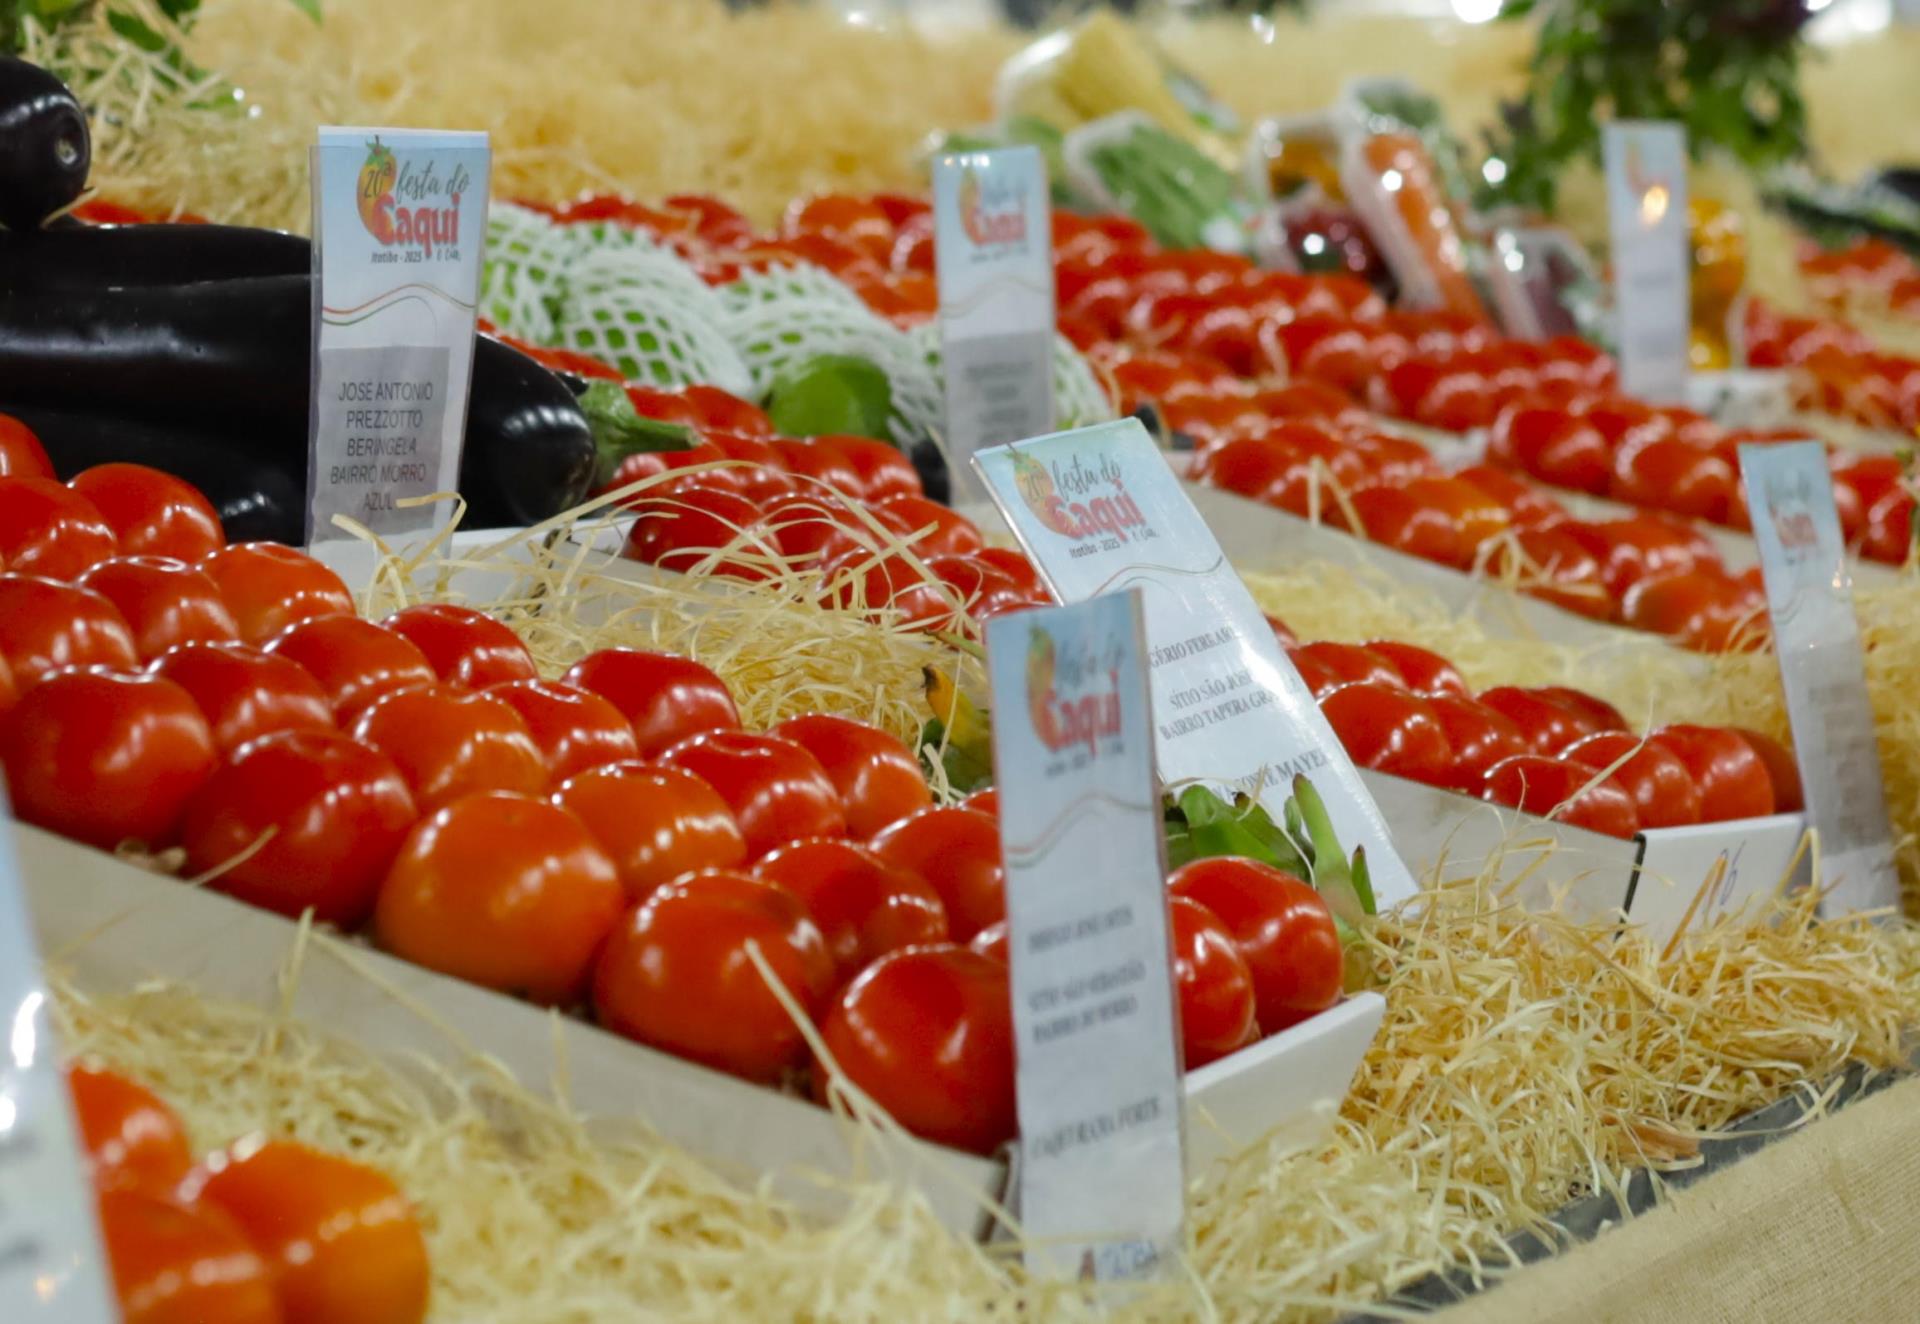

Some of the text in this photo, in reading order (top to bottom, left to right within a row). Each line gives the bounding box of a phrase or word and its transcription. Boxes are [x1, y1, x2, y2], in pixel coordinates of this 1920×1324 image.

[446, 163, 469, 195] do
[372, 191, 460, 257] Caqui
[404, 251, 422, 263] 2025
[375, 382, 433, 401] ANTONIO
[346, 410, 422, 429] PREZZOTTO
[347, 438, 417, 456] BERINGELA
[330, 463, 426, 484] BAIRRO MORRO
[363, 491, 393, 511] AZUL
[1046, 476, 1146, 541] Caqui
[1200, 679, 1227, 701] SÃO
[1160, 712, 1206, 740] BAIRRO
